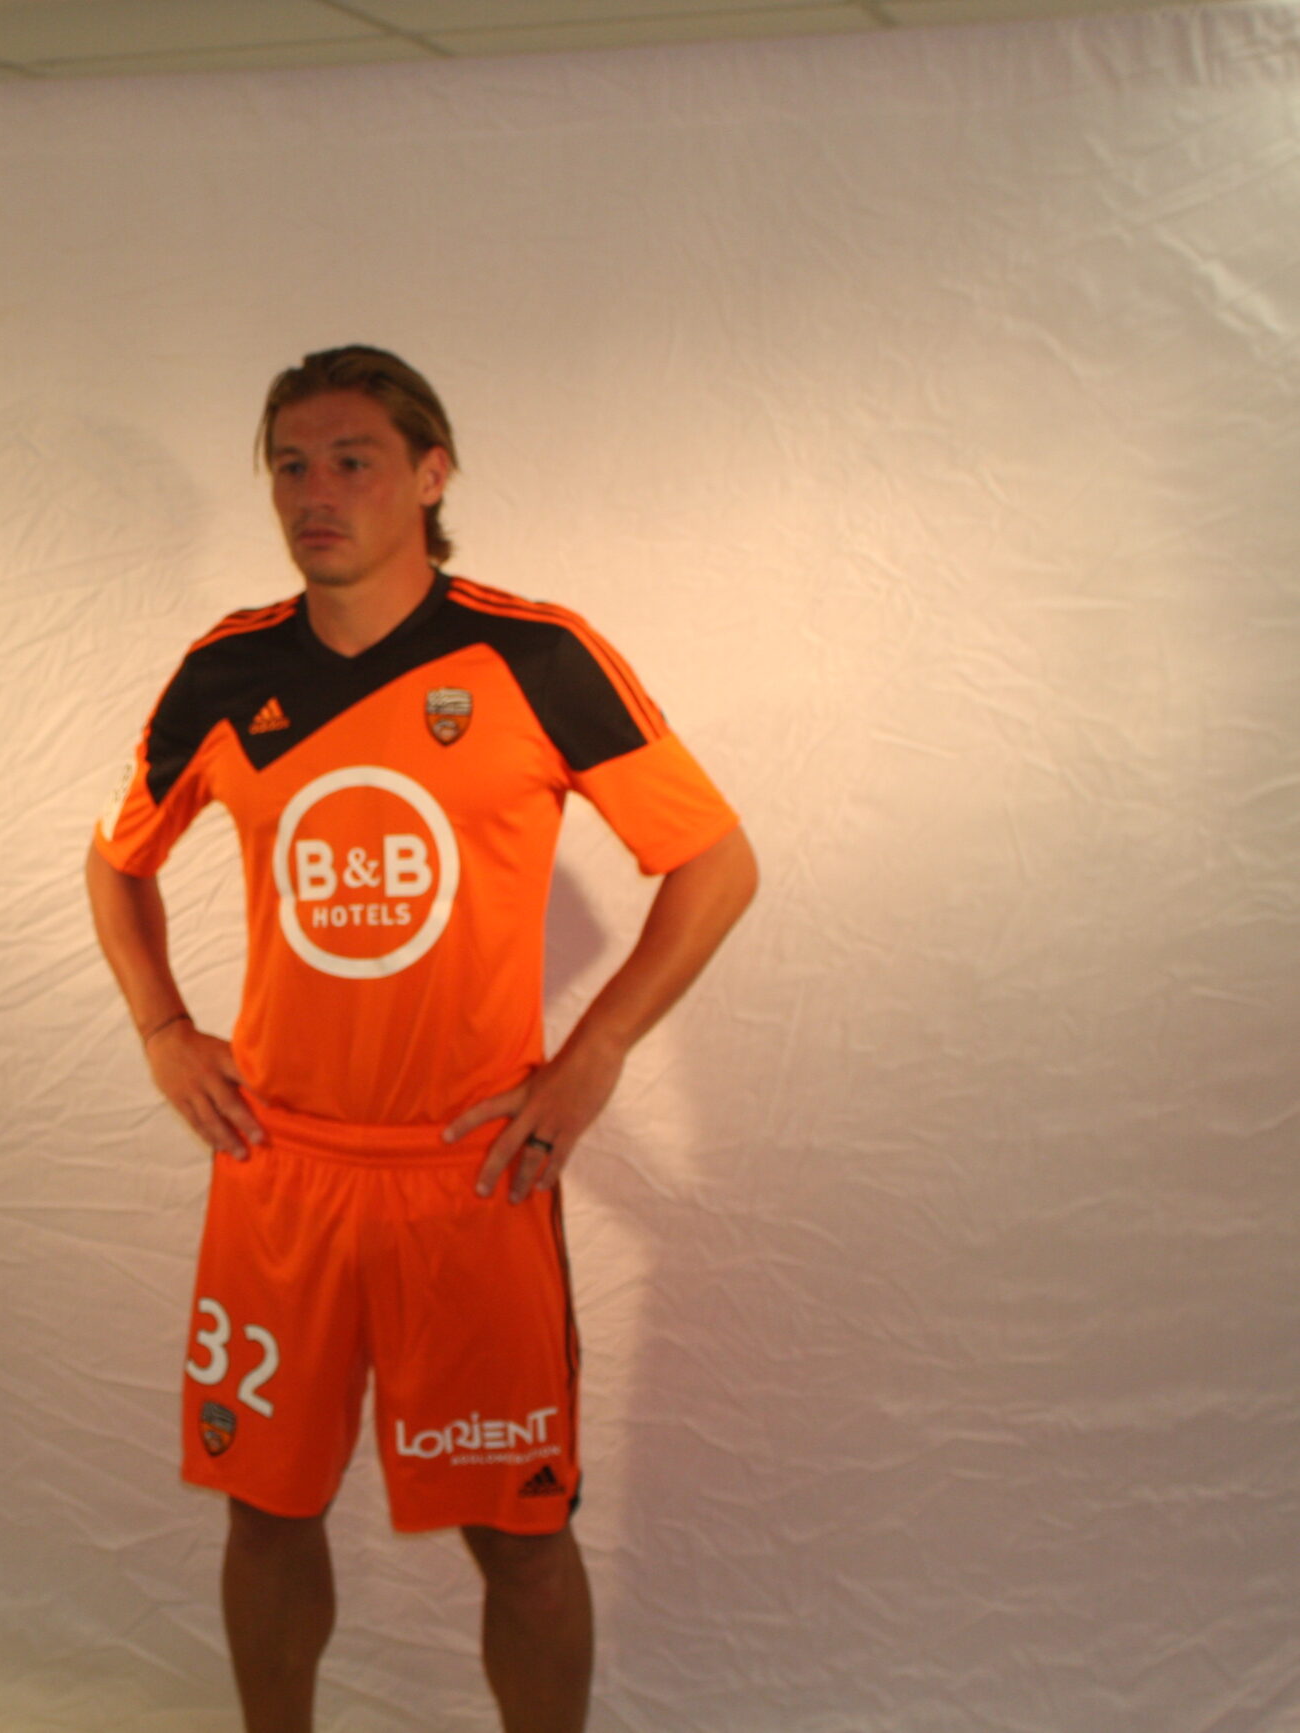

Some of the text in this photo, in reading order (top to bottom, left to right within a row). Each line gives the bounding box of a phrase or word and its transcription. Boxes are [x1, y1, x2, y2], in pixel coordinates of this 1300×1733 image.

[295, 833, 433, 902] B&B
[311, 902, 412, 929] HOTELS
[186, 1298, 280, 1418] 32
